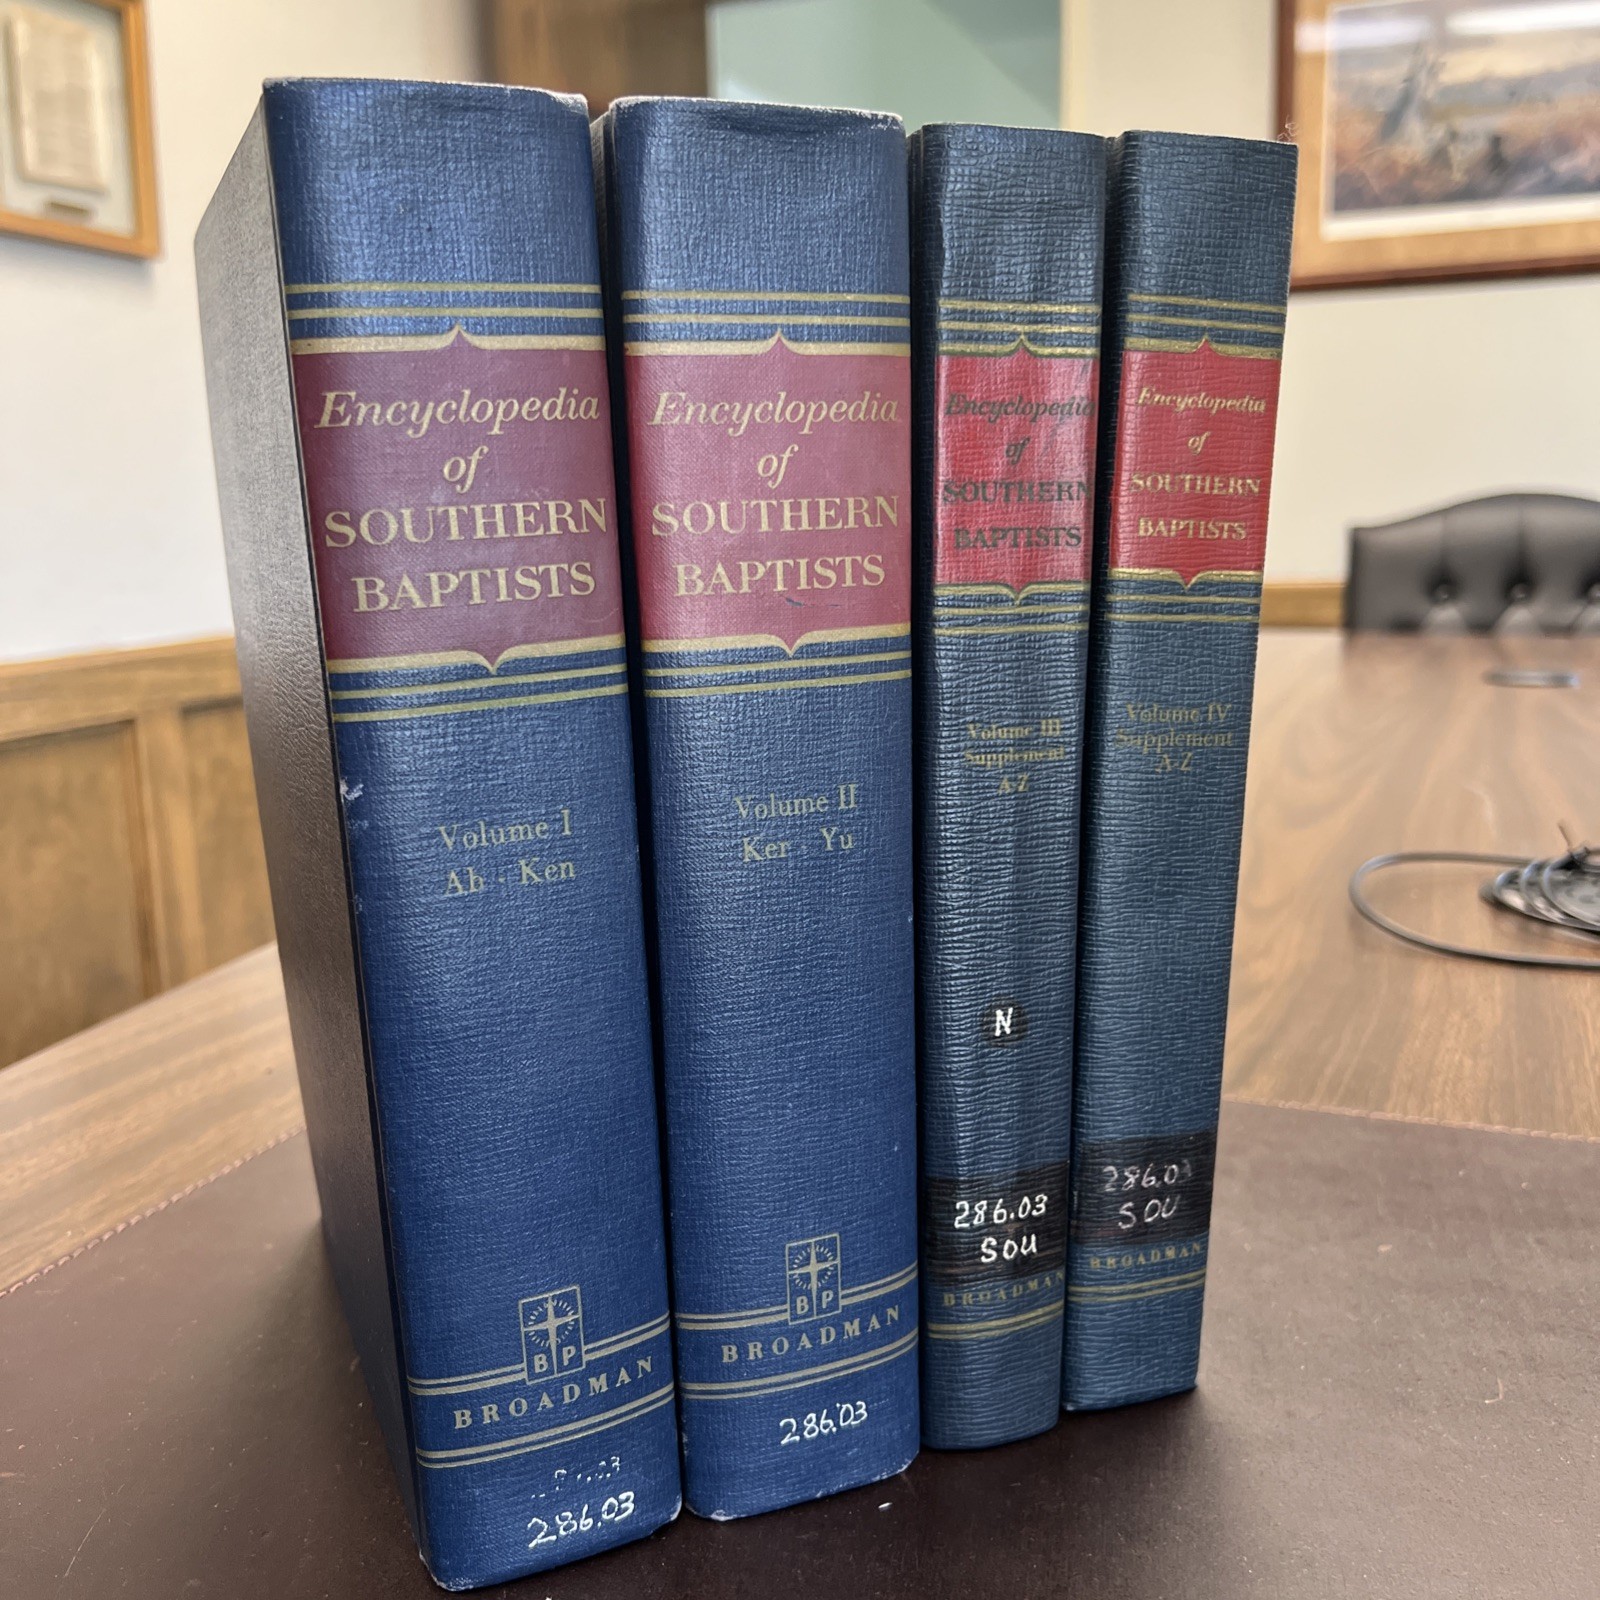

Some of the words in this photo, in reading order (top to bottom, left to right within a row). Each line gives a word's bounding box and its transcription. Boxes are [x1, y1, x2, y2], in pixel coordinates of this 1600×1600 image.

[314, 387, 600, 438] Encyclopedia
[647, 391, 899, 436] Encyclopedia
[945, 393, 1096, 423] Encyclopedia
[1137, 387, 1266, 415] Encyclopedia
[1005, 437, 1030, 465] of
[1187, 431, 1211, 455] of
[443, 446, 488, 493] of
[758, 444, 798, 489] of
[942, 480, 1093, 502] SOUTHERN
[1130, 473, 1261, 496] SOUTHERN
[325, 498, 607, 548] SOUTHERN
[651, 496, 899, 537] SOUTHERN
[1138, 517, 1247, 540] BAPTISTS
[954, 526, 1082, 549] BAPTISTS
[352, 562, 596, 612] BAPTISTS
[673, 555, 885, 597] BAPTISTS
[967, 722, 1033, 739] Volume
[1040, 718, 1061, 736] III
[1126, 703, 1200, 722] Volume
[1206, 703, 1232, 721] IV
[965, 745, 1065, 769] Supplement
[1115, 728, 1233, 755] Supplement
[734, 792, 829, 819] Volume
[838, 783, 858, 810] II
[438, 820, 550, 850] Volume
[560, 808, 572, 836] I
[742, 836, 790, 862] Ker
[820, 826, 855, 851] Yu
[443, 866, 485, 898] Ab
[518, 857, 576, 885] Ken
[993, 1007, 1013, 1036] N
[954, 1194, 1048, 1229] 286.03
[1118, 1194, 1181, 1229] SOU
[980, 1234, 1038, 1263] SOU
[1090, 1243, 1201, 1270] BROADMAN
[796, 1295, 810, 1315] B
[821, 1289, 834, 1309] P
[943, 1271, 1065, 1306] BROADMAN
[722, 1305, 900, 1363] BROADMAN
[533, 1353, 548, 1375] B
[562, 1345, 577, 1366] P
[454, 1357, 652, 1430] BROADMAN
[527, 1491, 635, 1547] 286.03
